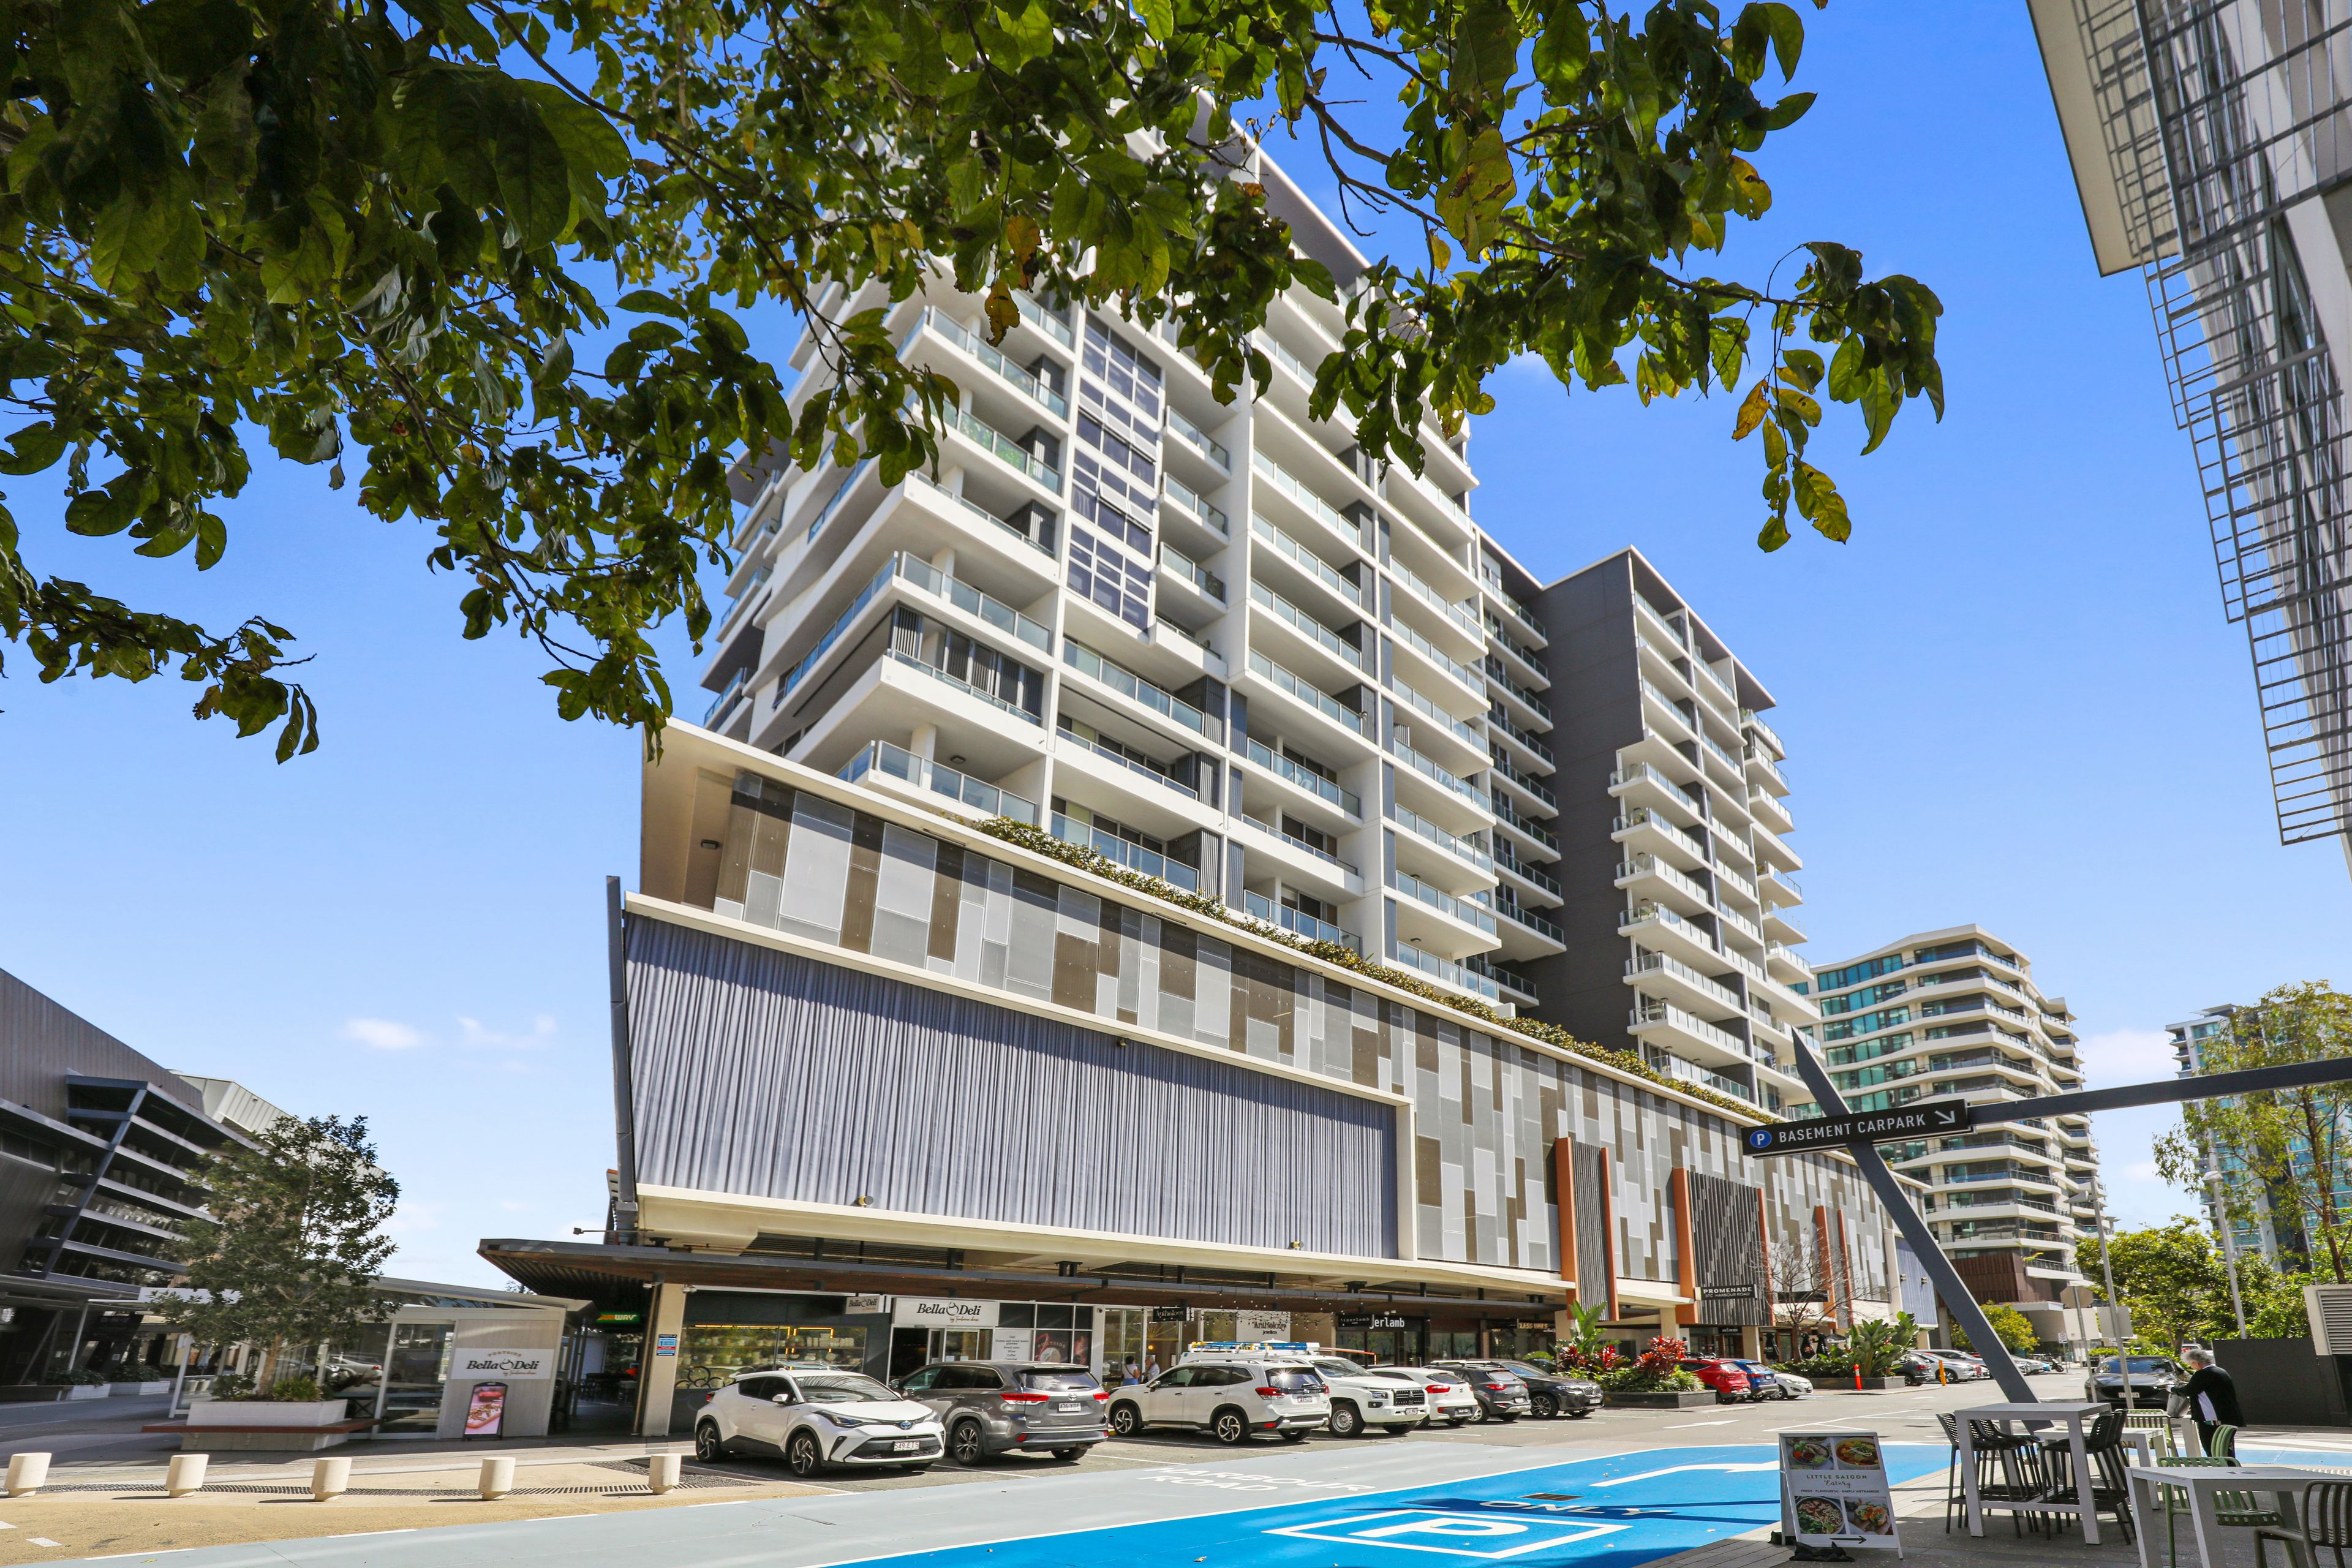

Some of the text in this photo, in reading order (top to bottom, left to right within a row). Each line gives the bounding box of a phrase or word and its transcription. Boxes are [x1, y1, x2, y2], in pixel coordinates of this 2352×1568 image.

[1757, 1114, 1926, 1145] P BASEMENT CARPARK
[916, 1303, 981, 1316] Bella Deli
[1370, 1317, 1405, 1329] erlamb
[466, 1360, 540, 1370] Bella Deli
[1137, 1476, 1278, 1491] ROAD
[1142, 1468, 1376, 1491] HARBOUR
[1824, 1480, 1851, 1488] Eatery
[1479, 1501, 1675, 1516] ONLY
